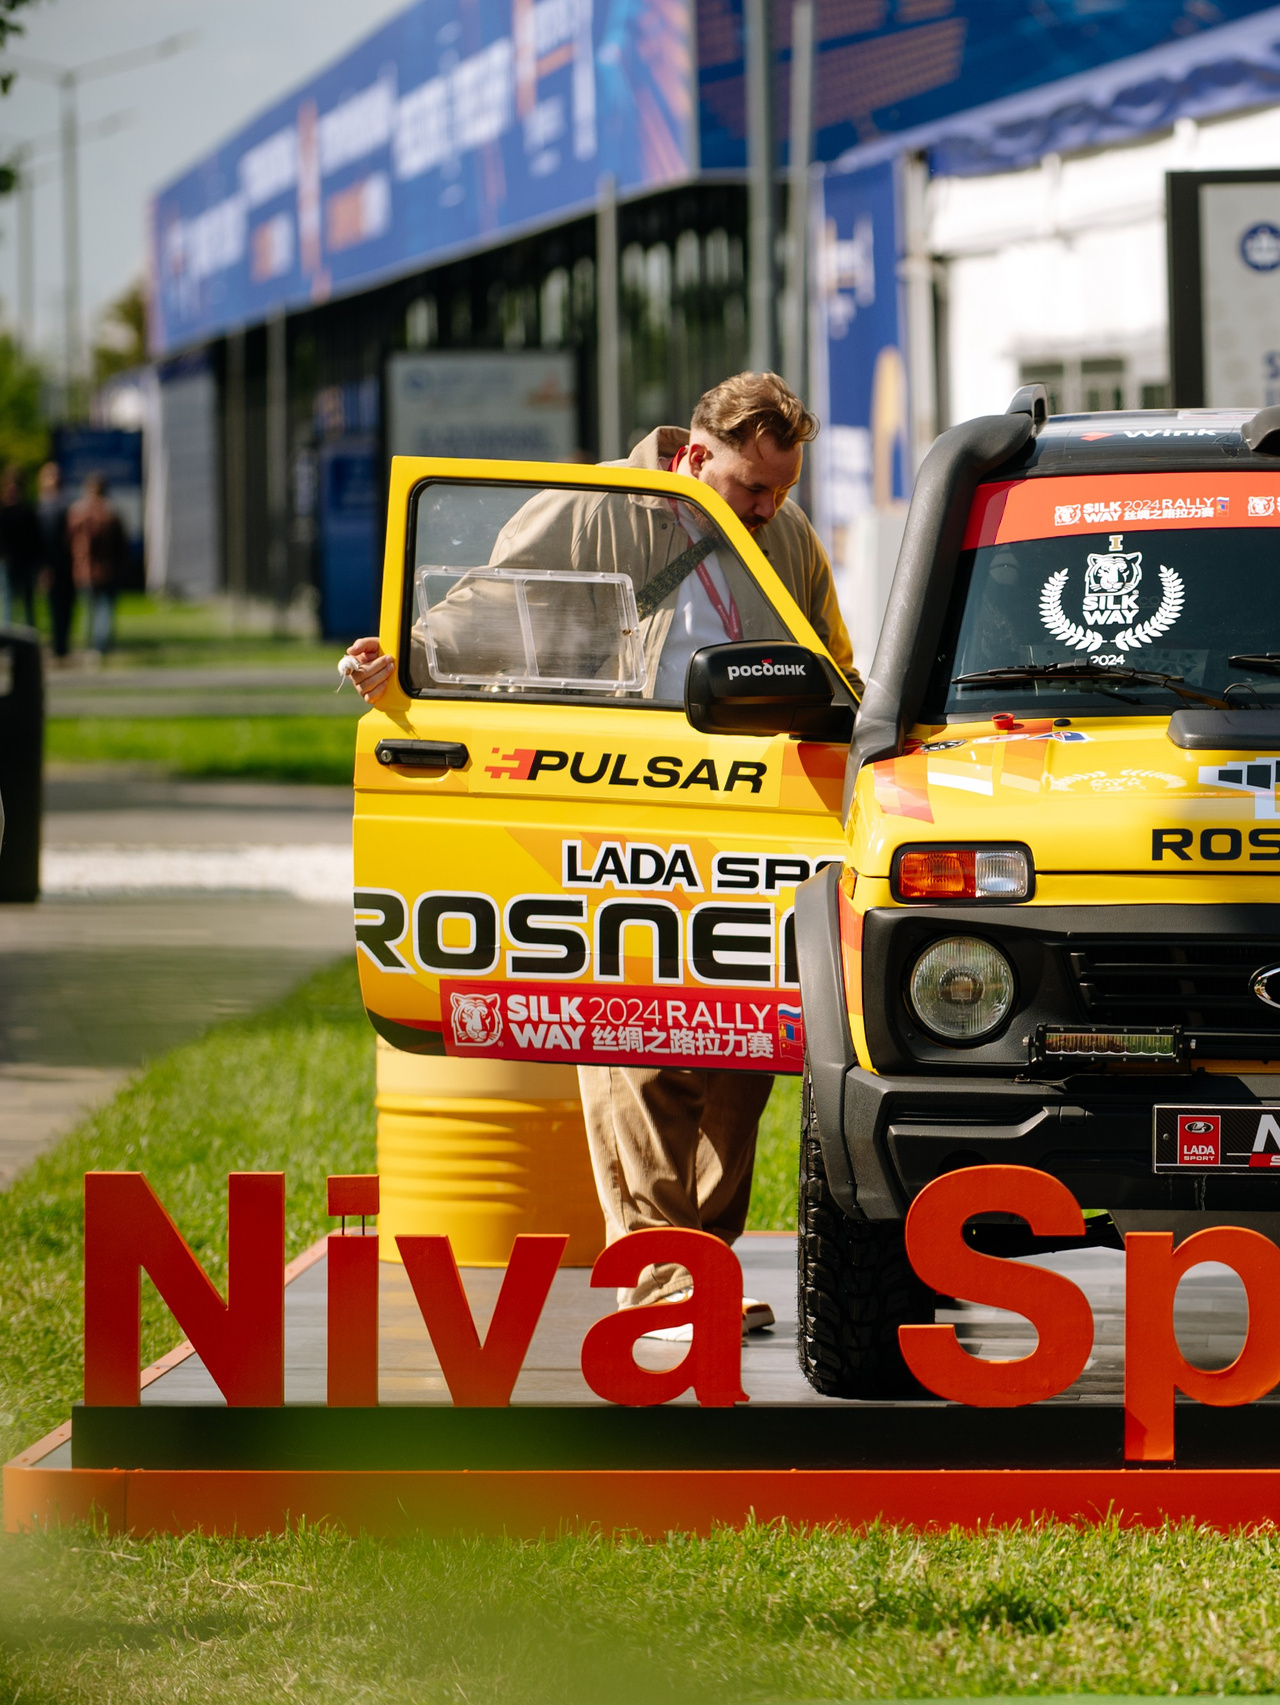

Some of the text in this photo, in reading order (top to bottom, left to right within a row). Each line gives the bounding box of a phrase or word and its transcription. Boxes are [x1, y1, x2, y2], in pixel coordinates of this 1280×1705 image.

[1083, 497, 1215, 514] SILK 2024 RALLY
[1084, 511, 1121, 523] WAY
[1123, 507, 1214, 520] 丝绸之路拉力赛
[1082, 595, 1139, 611] SILK
[1082, 609, 1139, 625] WAY
[727, 660, 806, 680] росбанк
[527, 750, 768, 794] PULSAR
[564, 842, 845, 892] LADA SP
[354, 889, 801, 988] ROSNE
[507, 995, 771, 1030] SILK 2024 RALLY
[509, 1023, 586, 1050] WAY
[591, 1025, 774, 1059] 丝绸之路拉力赛
[1183, 1145, 1215, 1155] LADA
[84, 1171, 750, 1407] Niva
